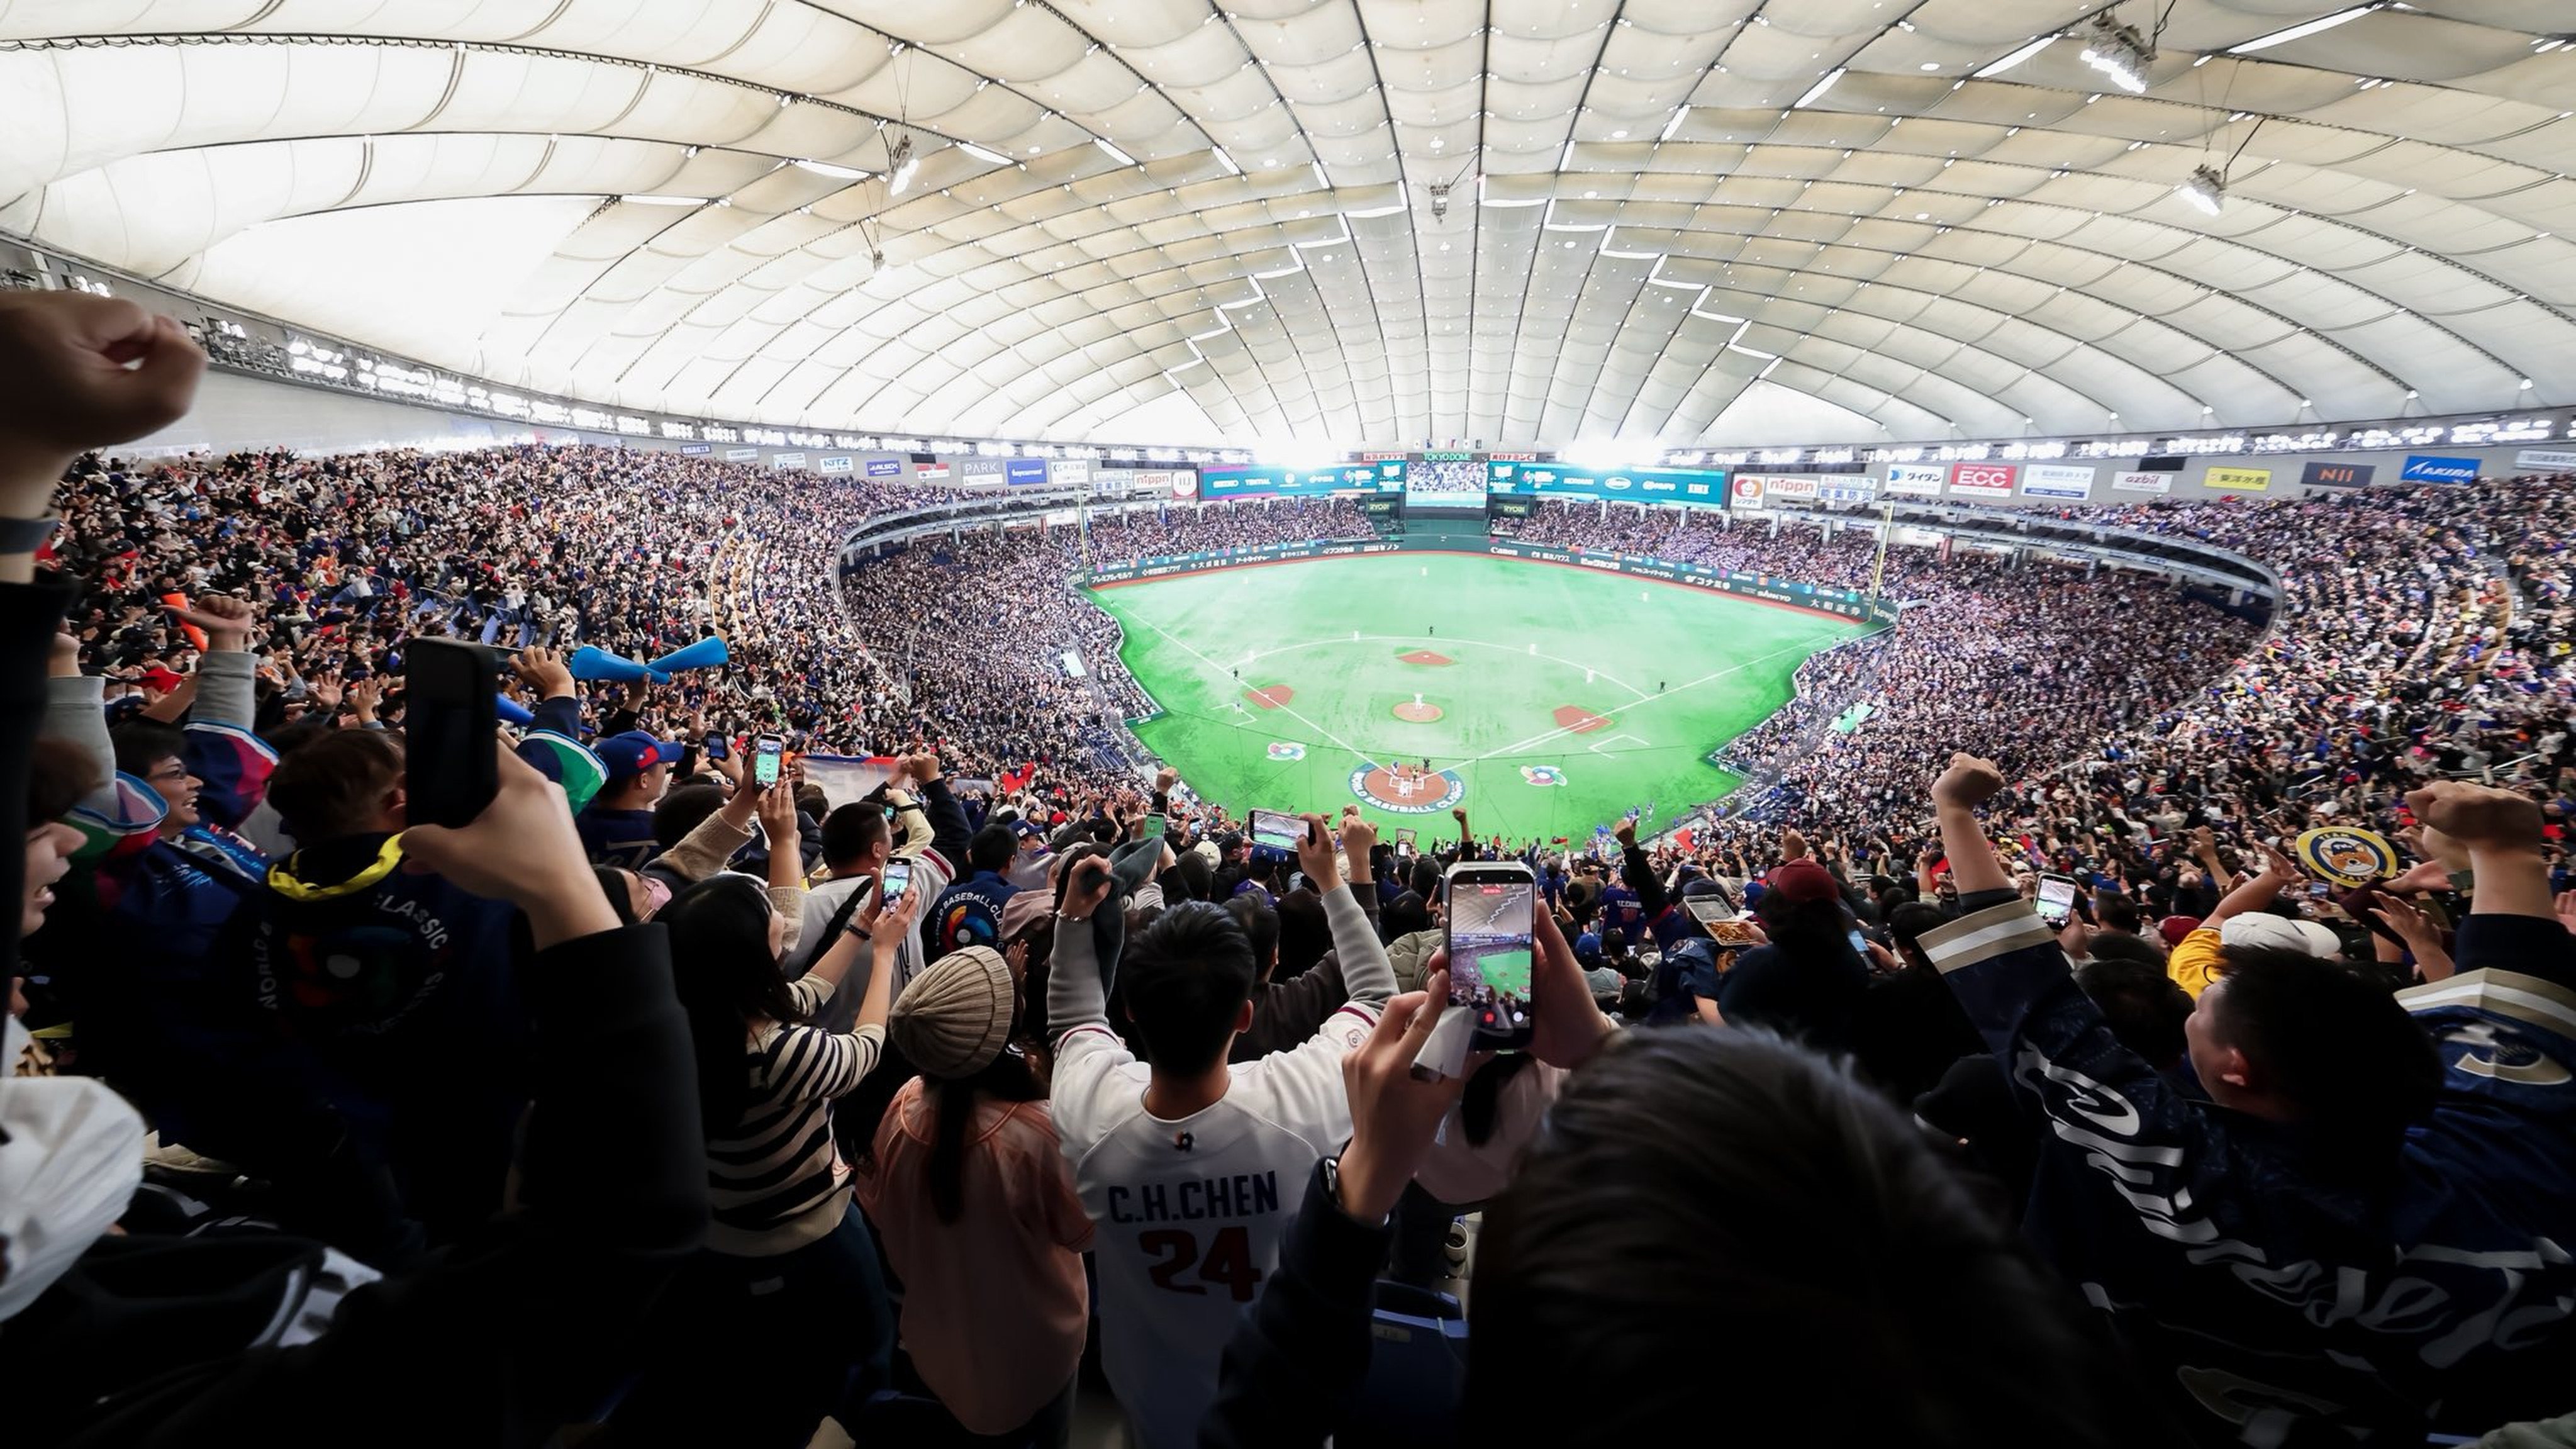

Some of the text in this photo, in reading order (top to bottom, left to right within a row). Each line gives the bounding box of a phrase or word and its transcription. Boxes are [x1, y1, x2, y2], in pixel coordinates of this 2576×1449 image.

[1424, 452, 1472, 461] TOKYO DOME
[965, 462, 998, 474] PARK
[1137, 475, 1169, 485] nippn
[1957, 471, 2007, 486] ECC
[2126, 474, 2160, 484] azbil
[1770, 480, 1814, 492] nippn
[1490, 547, 1519, 556] Canon
[1351, 772, 1368, 797] WORLD
[1364, 796, 1436, 814] BASEBALL
[943, 892, 991, 909] BASEBALL
[373, 893, 449, 949] LASSIC
[1108, 1171, 1279, 1223] C.H.CHEN
[1139, 1226, 1262, 1302] 24
